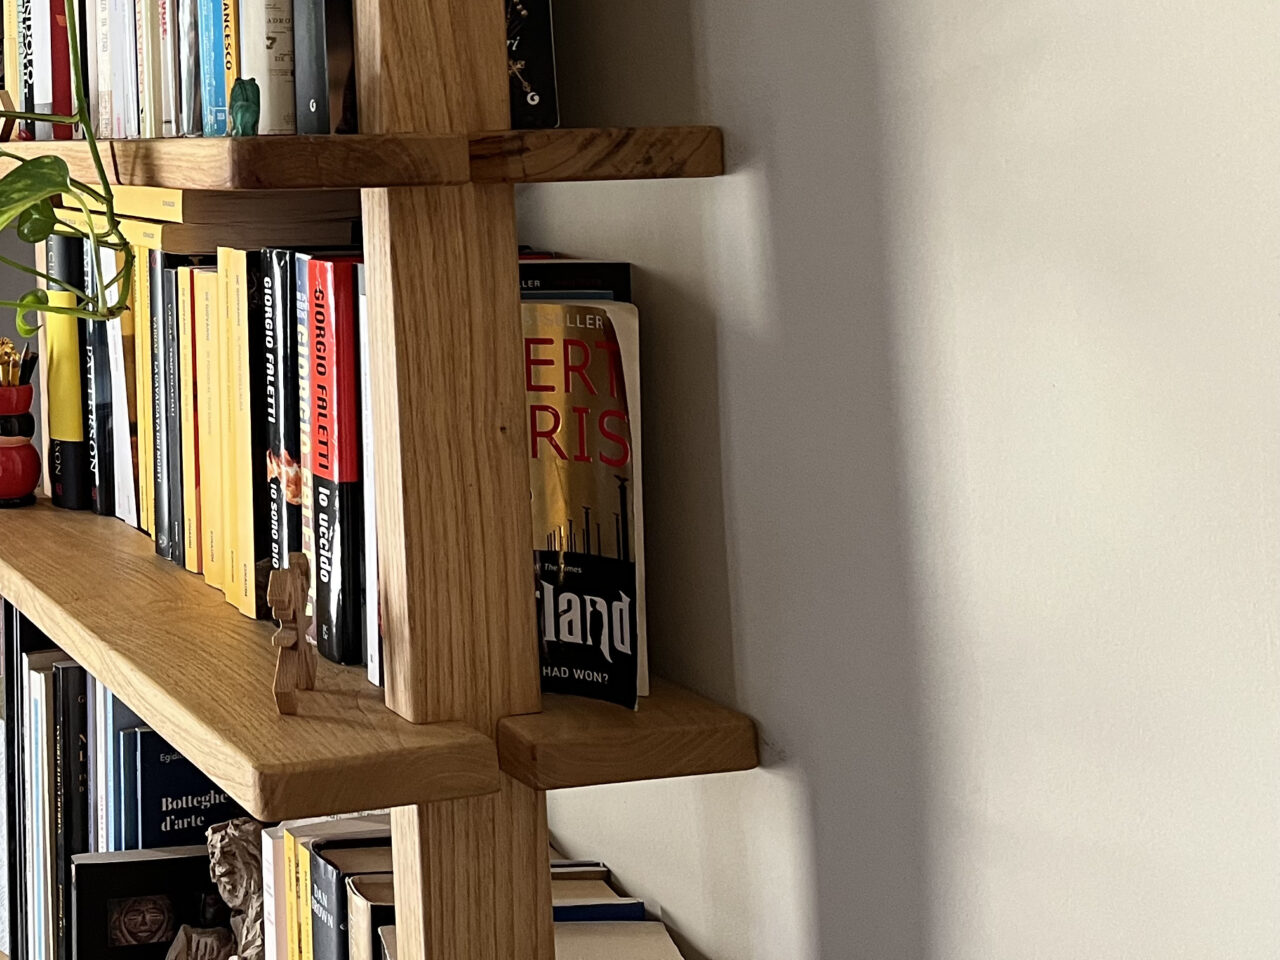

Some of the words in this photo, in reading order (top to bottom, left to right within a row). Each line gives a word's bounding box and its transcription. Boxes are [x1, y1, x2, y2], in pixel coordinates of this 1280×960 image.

[263, 276, 274, 349] GIORGIO
[314, 288, 327, 377] GIORGIO
[265, 352, 277, 424] FALETTI
[524, 338, 619, 400] ERT
[316, 383, 330, 471] FALETTI
[529, 404, 632, 469] RIS
[318, 486, 331, 508] Io
[319, 515, 334, 583] uccido
[536, 579, 632, 664] land
[542, 666, 569, 679] HAD
[573, 668, 609, 684] WON?
[160, 753, 184, 763] Egidi
[161, 790, 229, 812] Botteghe
[161, 815, 205, 832] d'arte
[313, 883, 328, 908] DAN
